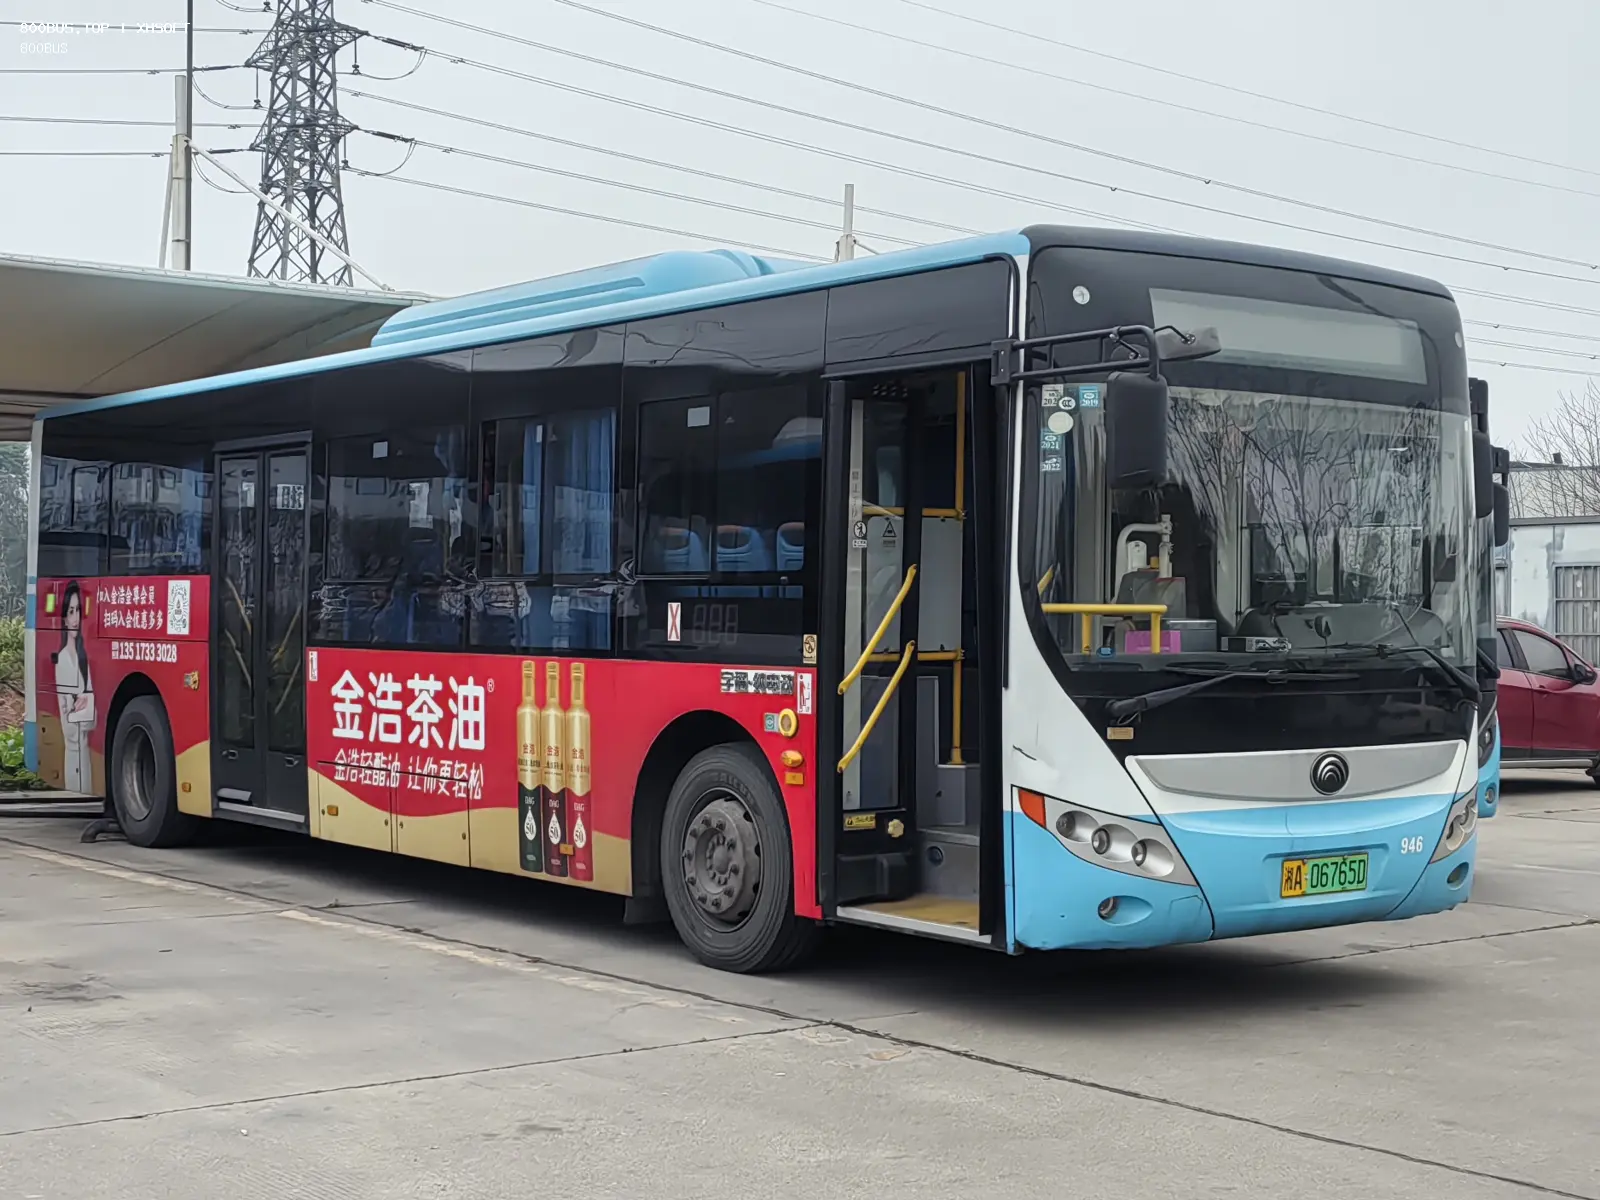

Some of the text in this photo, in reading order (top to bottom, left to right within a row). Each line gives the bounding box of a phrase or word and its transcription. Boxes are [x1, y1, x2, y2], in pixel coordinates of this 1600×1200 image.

[104, 609, 163, 630] 扫码入会优惠多多
[120, 642, 134, 660] 135
[135, 642, 156, 662] 1733
[156, 644, 177, 663] 3028
[330, 669, 486, 751] 金浩茶油
[407, 755, 484, 800] 让你更轻松
[1400, 836, 1424, 855] 946
